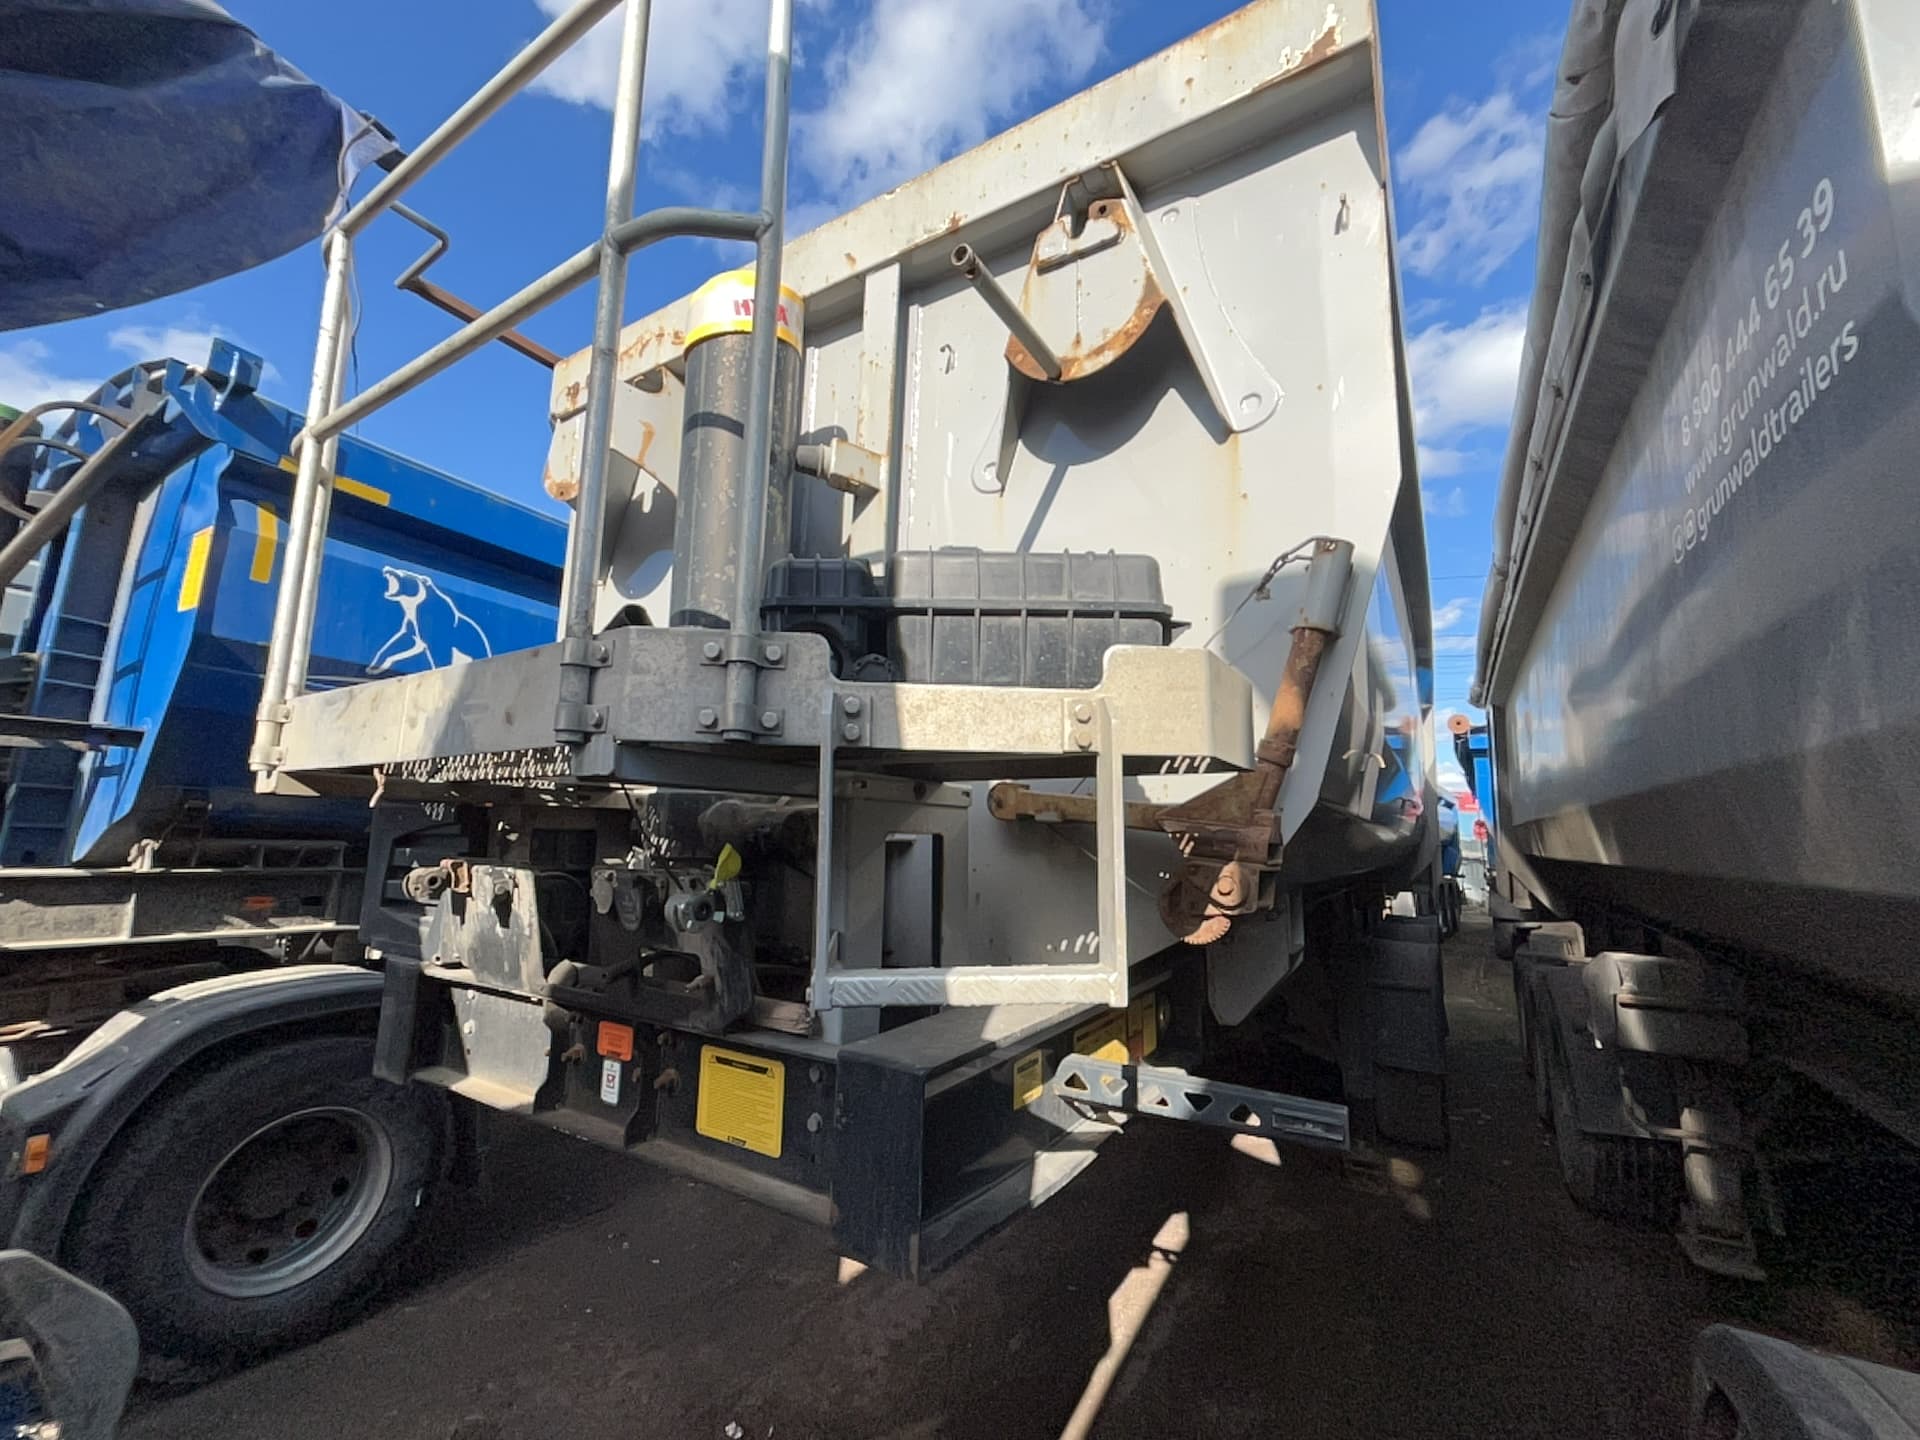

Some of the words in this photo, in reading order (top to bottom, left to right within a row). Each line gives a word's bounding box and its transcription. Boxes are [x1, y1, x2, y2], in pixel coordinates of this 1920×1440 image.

[1680, 415, 1691, 447] 8
[1725, 295, 1761, 374] 444
[1764, 238, 1795, 310] 65
[1796, 176, 1835, 260] 39
[1684, 249, 1849, 495] www.grunwald.ru
